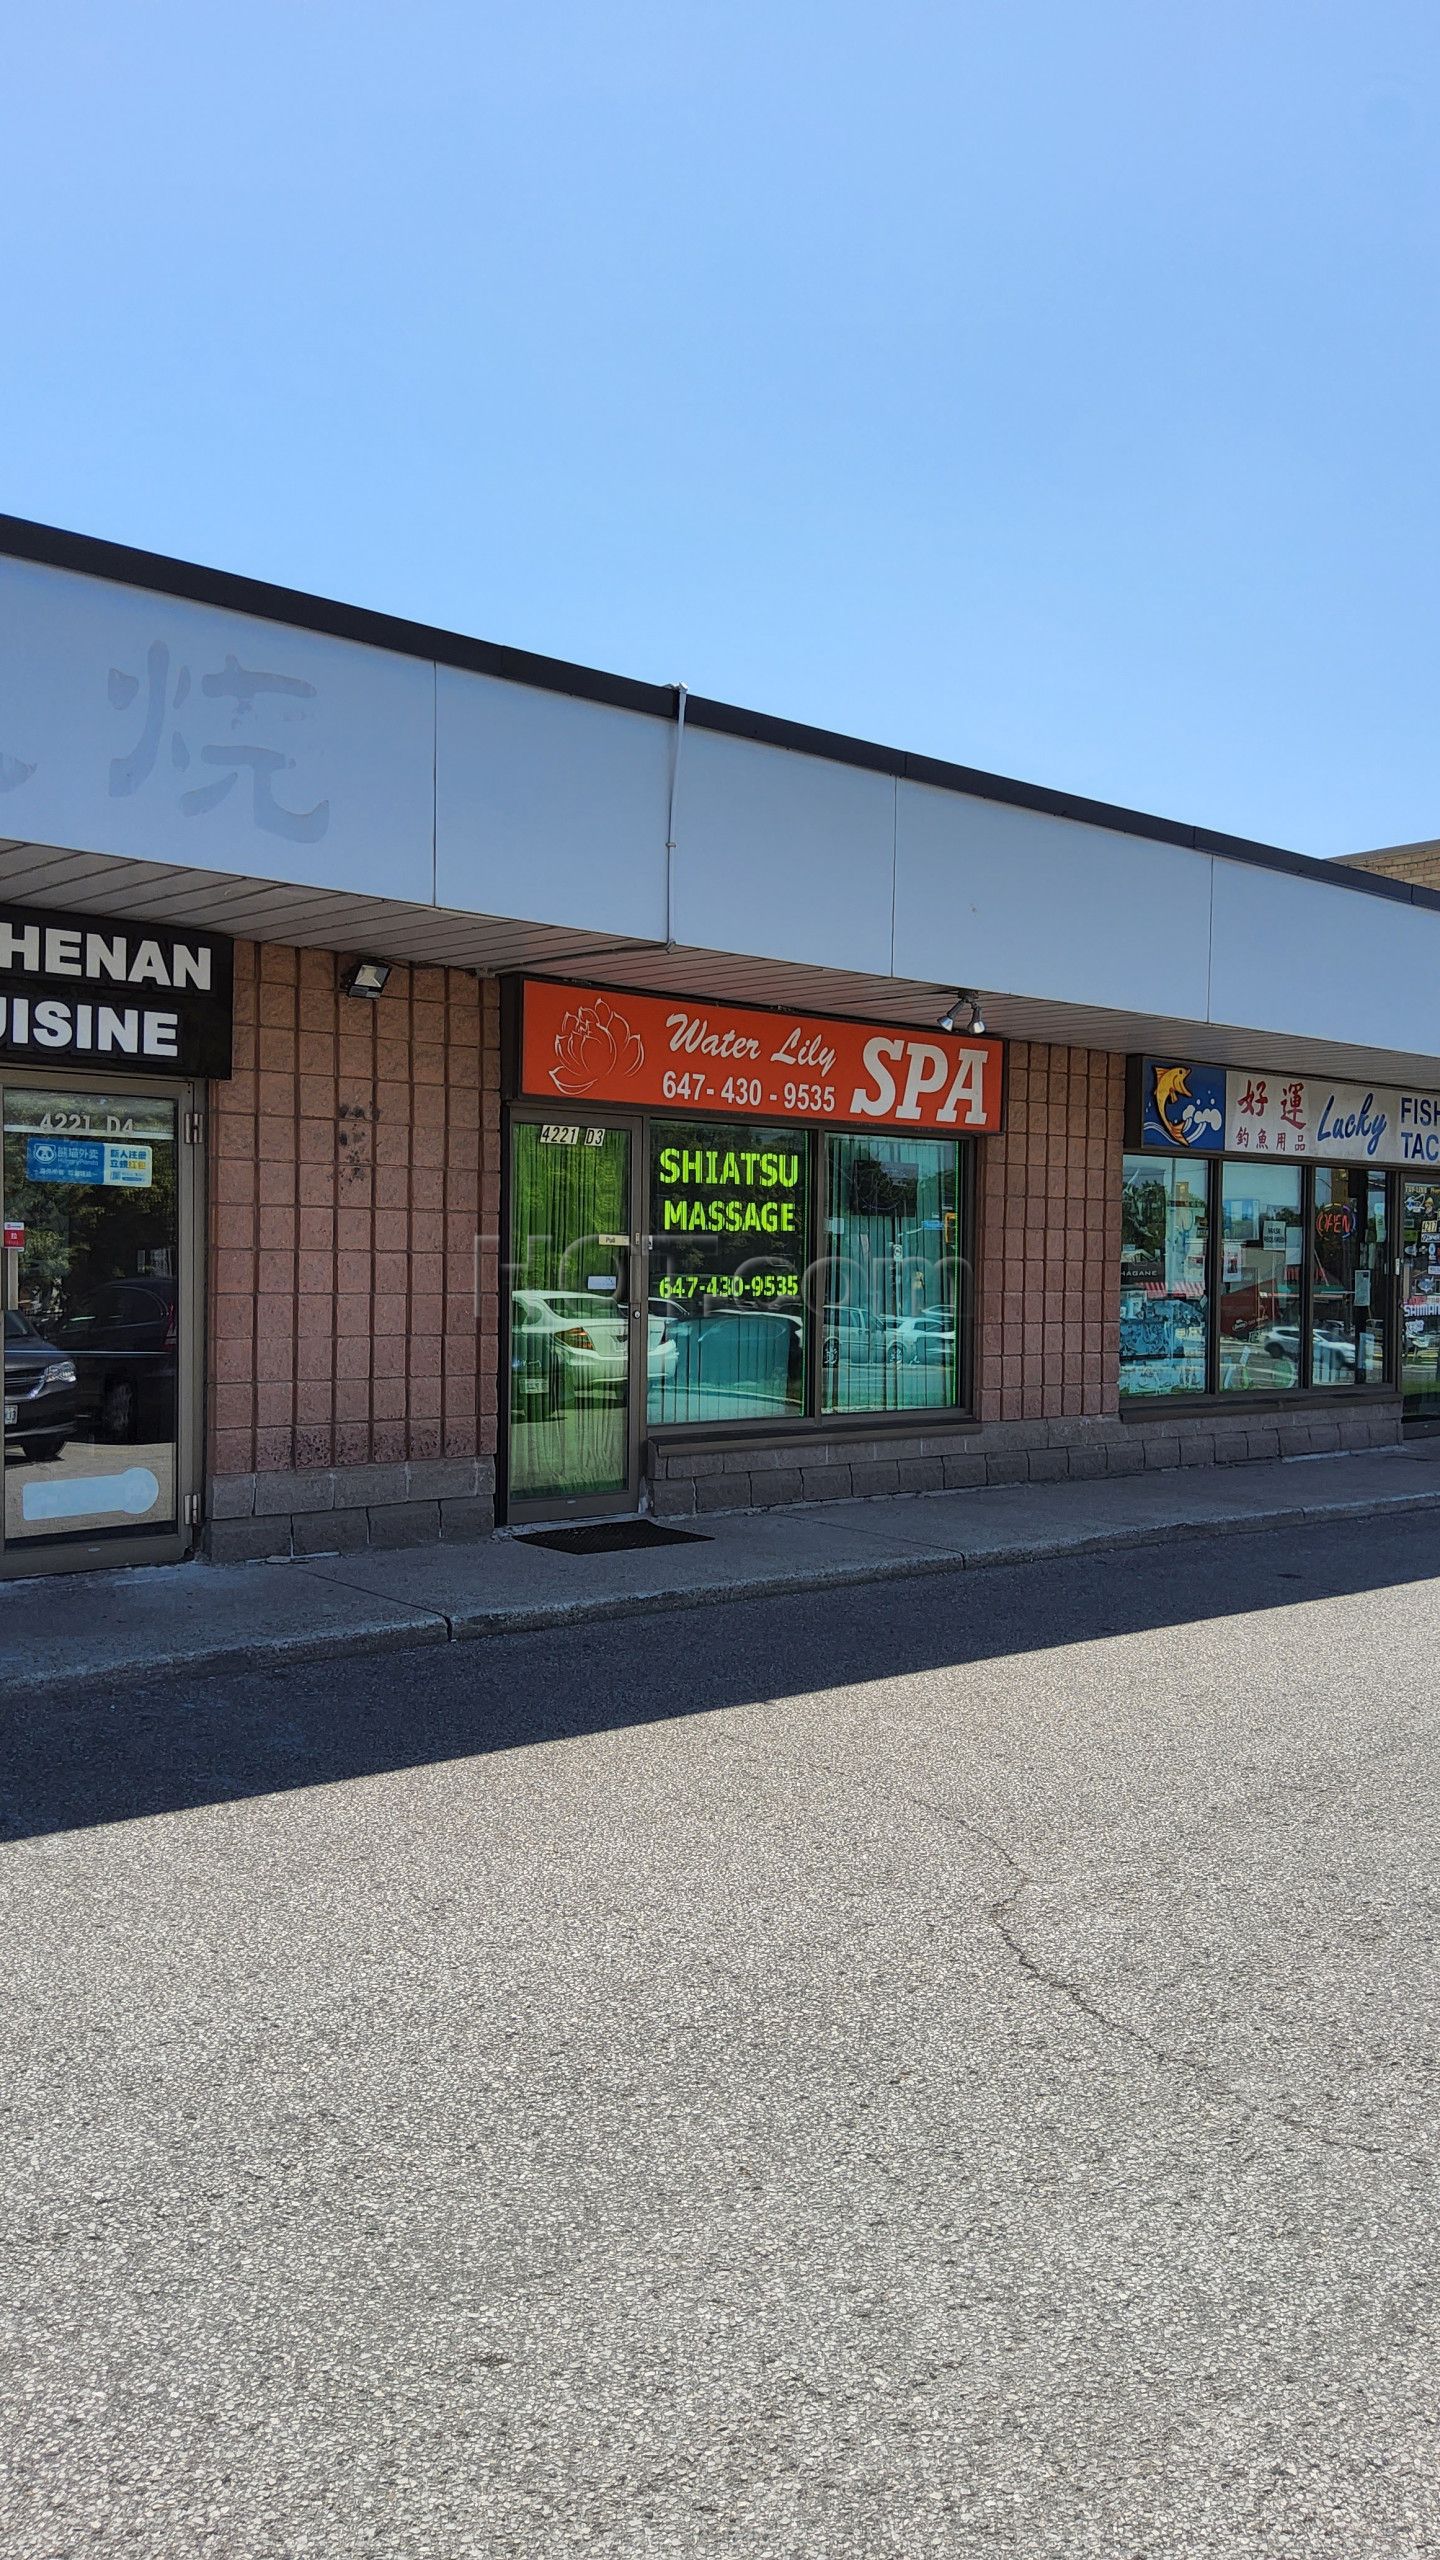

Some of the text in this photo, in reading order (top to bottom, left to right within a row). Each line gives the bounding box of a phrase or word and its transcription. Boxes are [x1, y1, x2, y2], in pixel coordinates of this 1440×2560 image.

[0, 922, 211, 991] HENAN
[0, 996, 178, 1057] ISINE
[666, 1013, 837, 1078] Water Lily
[850, 1036, 989, 1125] SPA
[40, 1113, 135, 1136] 4221 D4
[1237, 1080, 1306, 1130] 好運
[1317, 1093, 1387, 1155] Lucky
[542, 1126, 604, 1145] 4221 D3
[1235, 1127, 1306, 1152] 釣魚用品
[659, 1148, 798, 1188] SHIATSU
[664, 1200, 796, 1232] MASSAGE
[1318, 1213, 1351, 1233] OPEN
[659, 1275, 798, 1299] 647-430-9535
